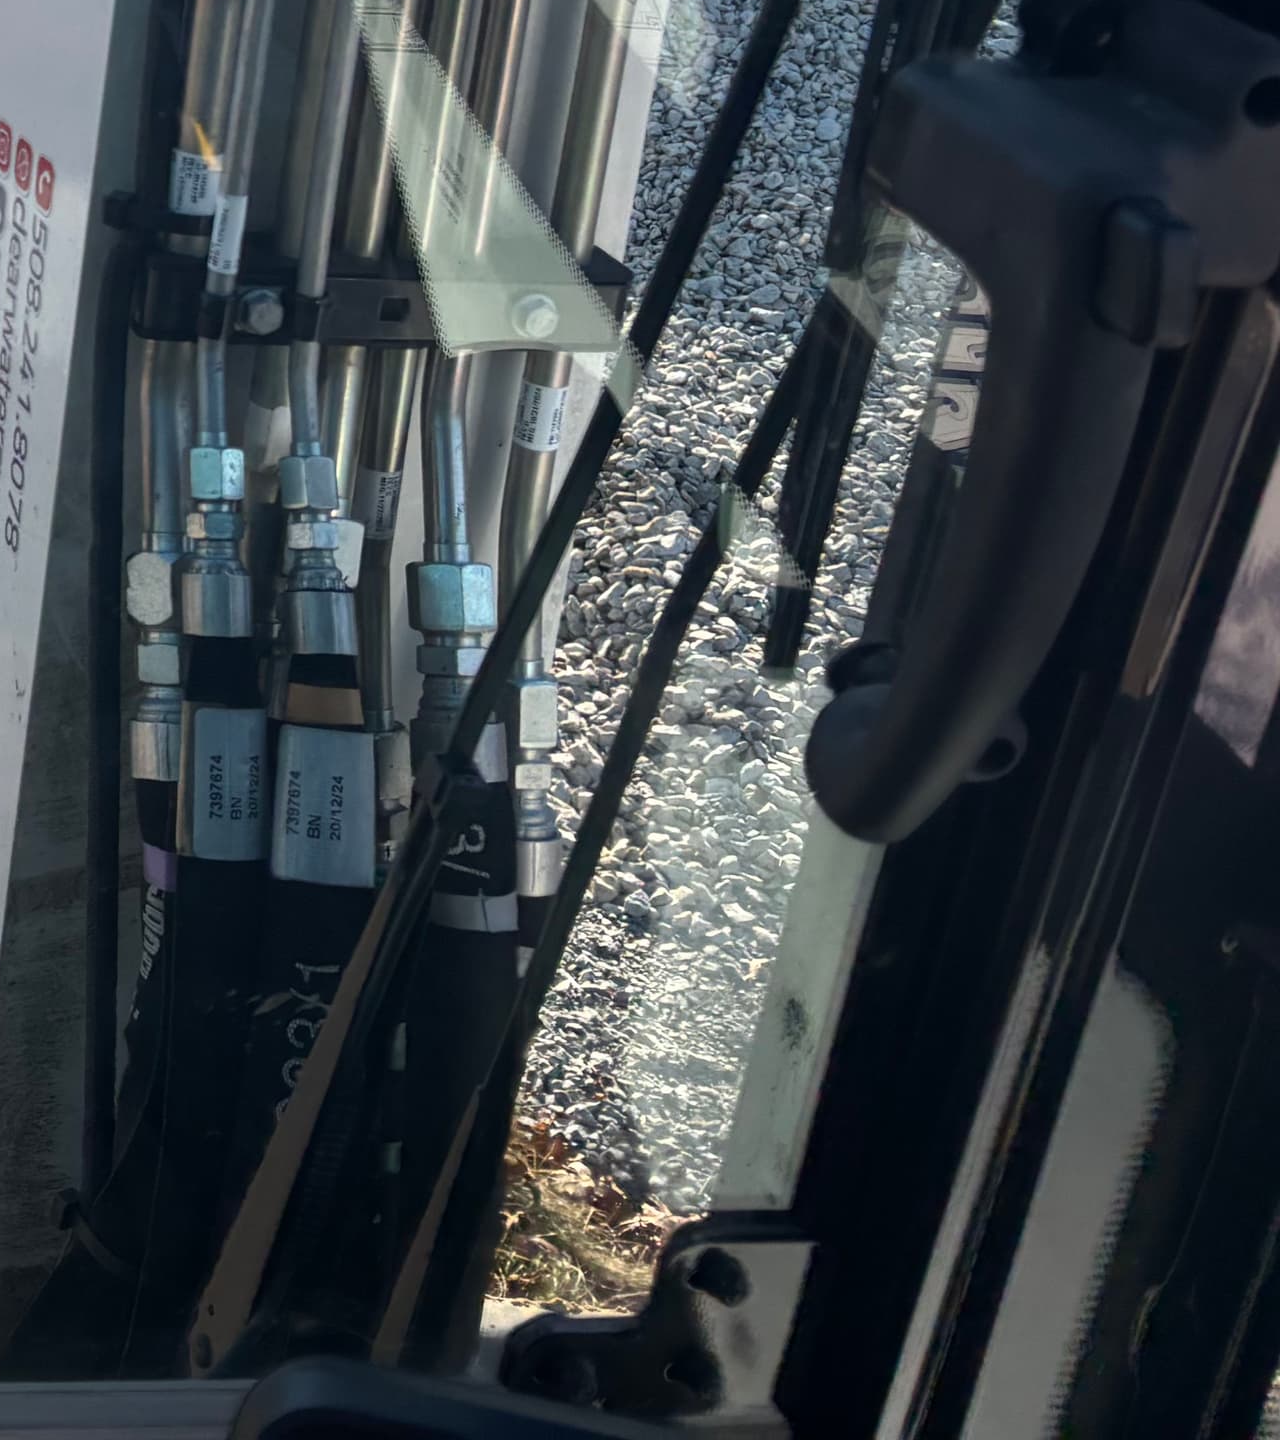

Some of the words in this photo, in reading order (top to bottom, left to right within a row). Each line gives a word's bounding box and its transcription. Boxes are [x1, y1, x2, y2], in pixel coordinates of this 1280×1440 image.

[5, 219, 49, 553] 508.241.8078
[209, 755, 223, 819] 7397674
[230, 796, 243, 820] BN
[248, 755, 260, 820] 20/12/24
[286, 771, 301, 835] 7397674
[329, 776, 344, 841] 20/12/24
[307, 814, 321, 839] BN
